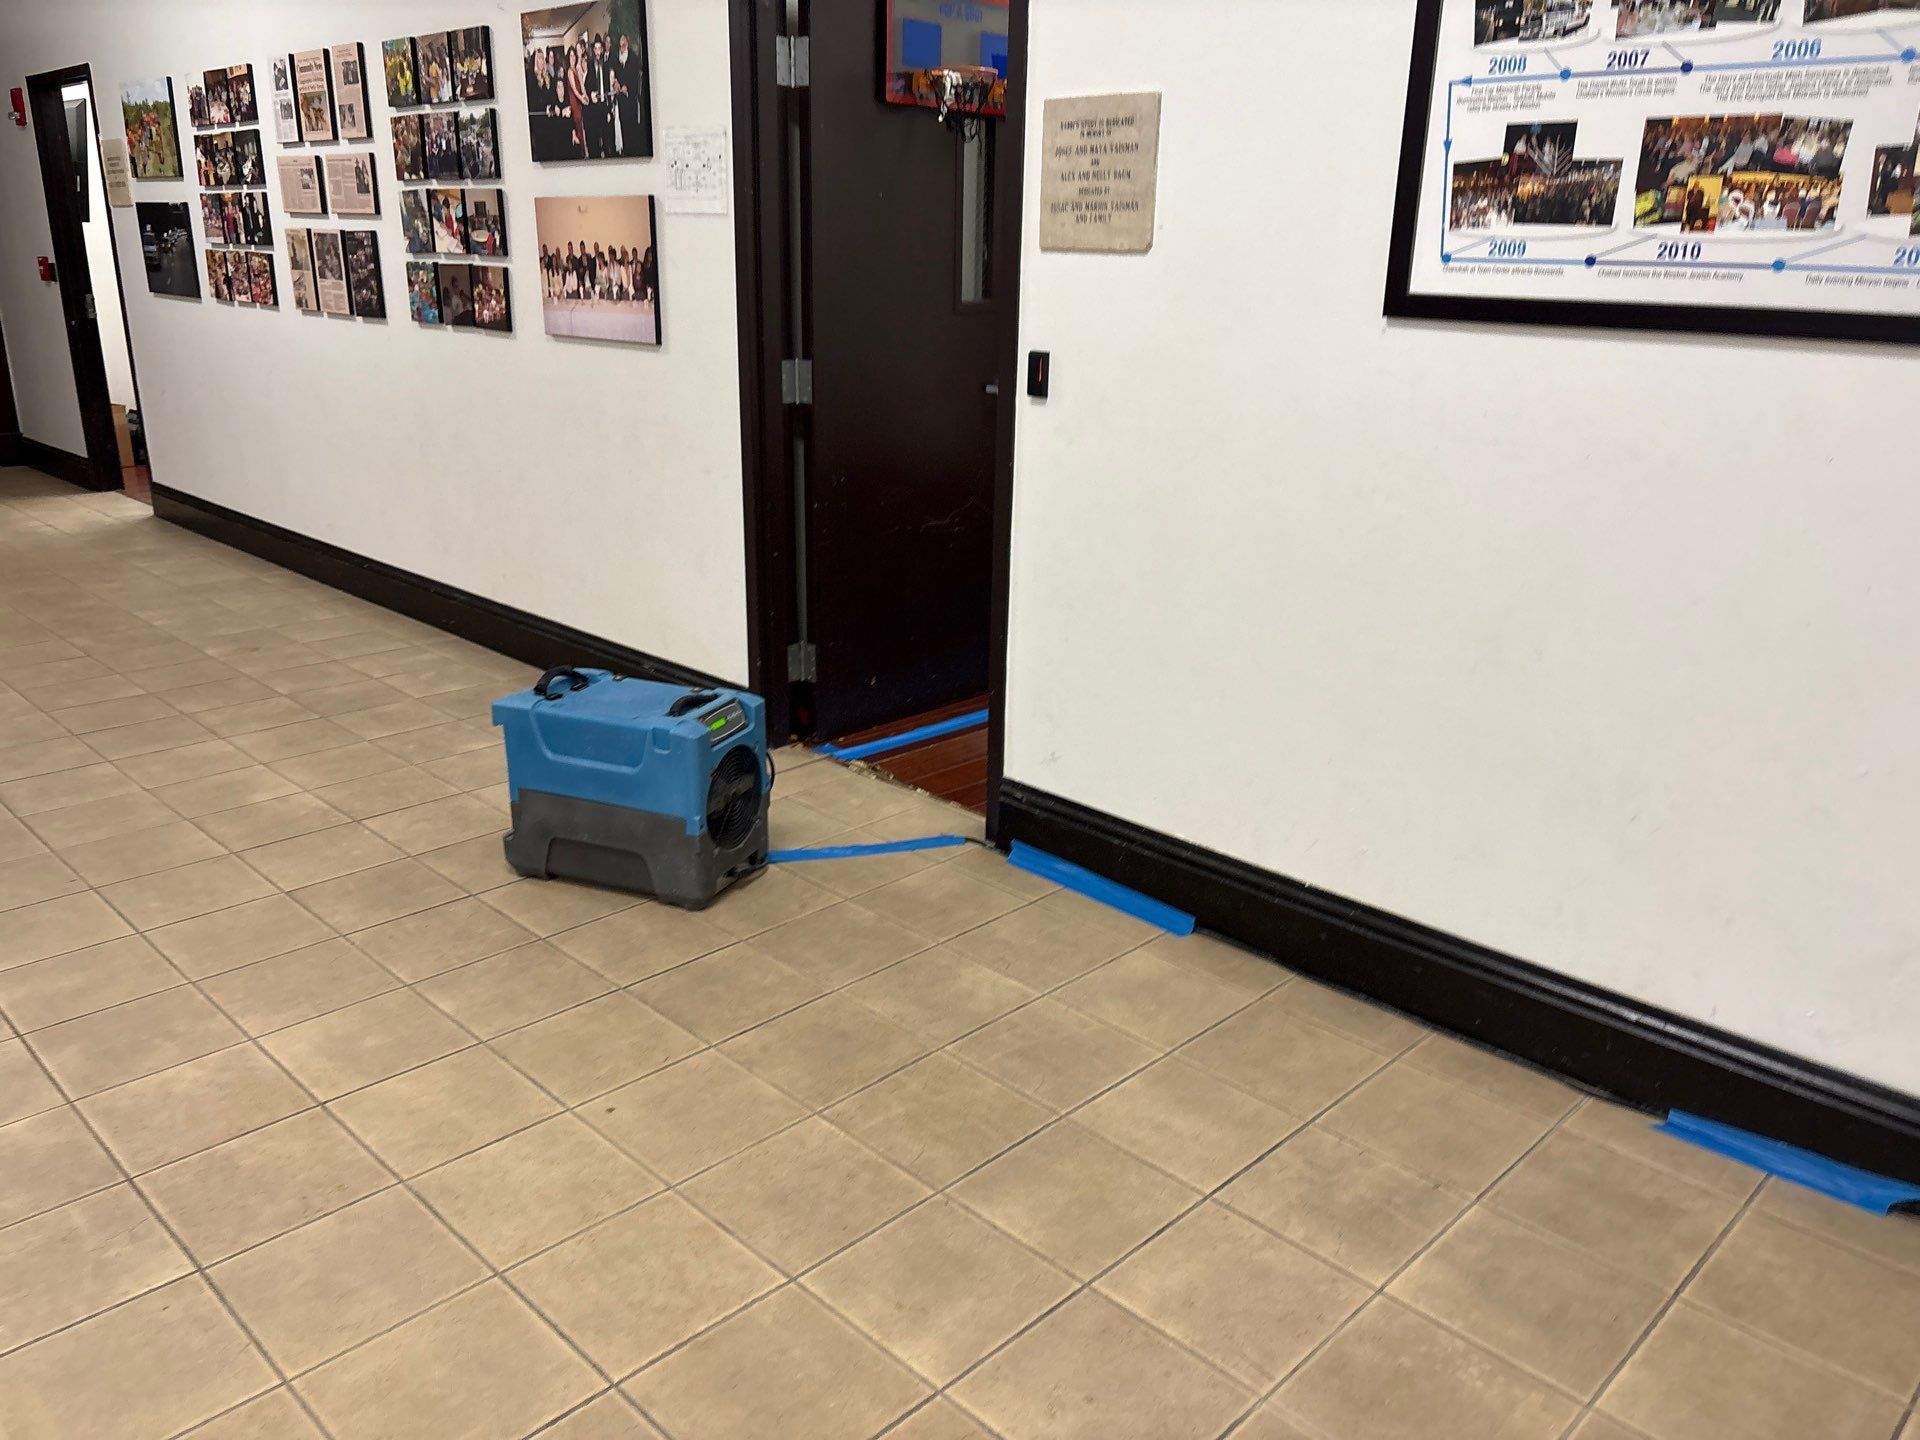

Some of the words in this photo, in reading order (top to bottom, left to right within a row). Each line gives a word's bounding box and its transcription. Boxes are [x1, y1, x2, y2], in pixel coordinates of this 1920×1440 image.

[1606, 49, 1650, 69] 2007
[1075, 144, 1088, 156] AND
[1078, 170, 1091, 182] AND
[1075, 213, 1088, 225] AND
[1656, 241, 1702, 261] 2010
